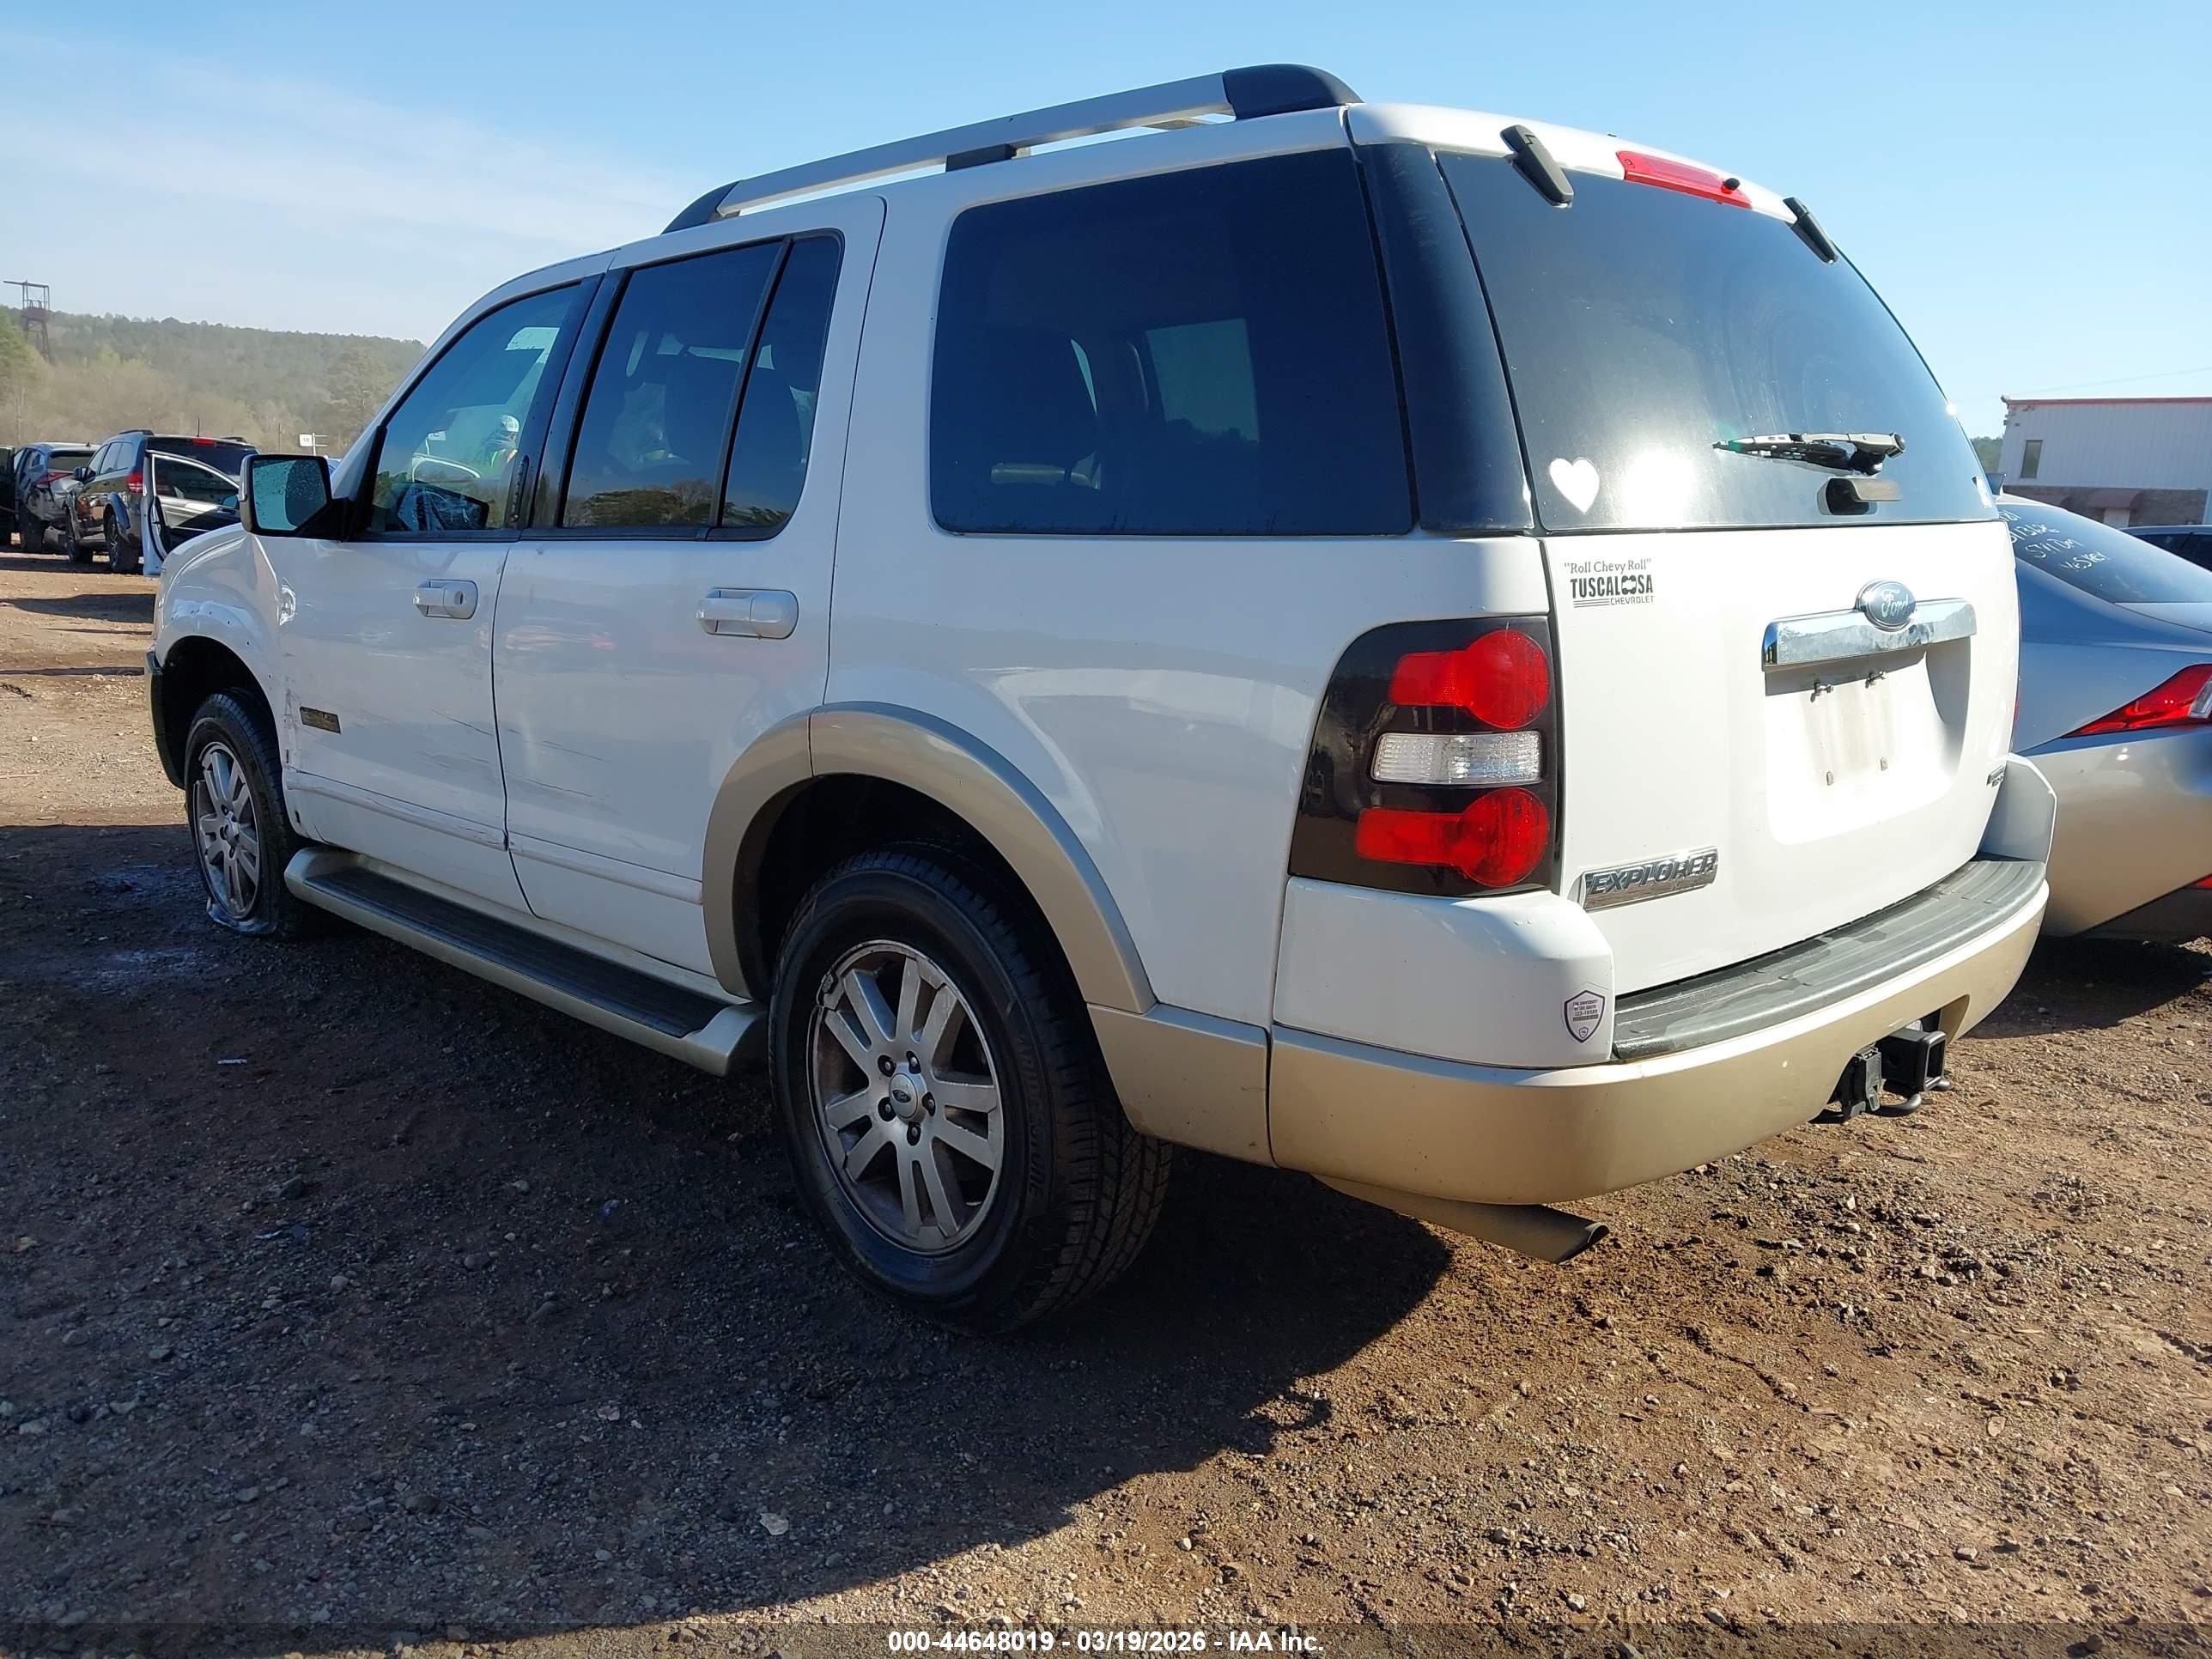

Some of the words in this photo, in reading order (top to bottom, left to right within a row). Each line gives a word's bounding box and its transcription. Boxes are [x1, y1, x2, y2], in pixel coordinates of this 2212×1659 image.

[1565, 562, 1591, 574] "Roll
[1594, 561, 1626, 574] Chevy
[1628, 558, 1651, 570] Roll"
[1610, 595, 1655, 605] CHEVROLET
[1881, 589, 1910, 617] Ford
[1589, 853, 1718, 896] EXPLORER
